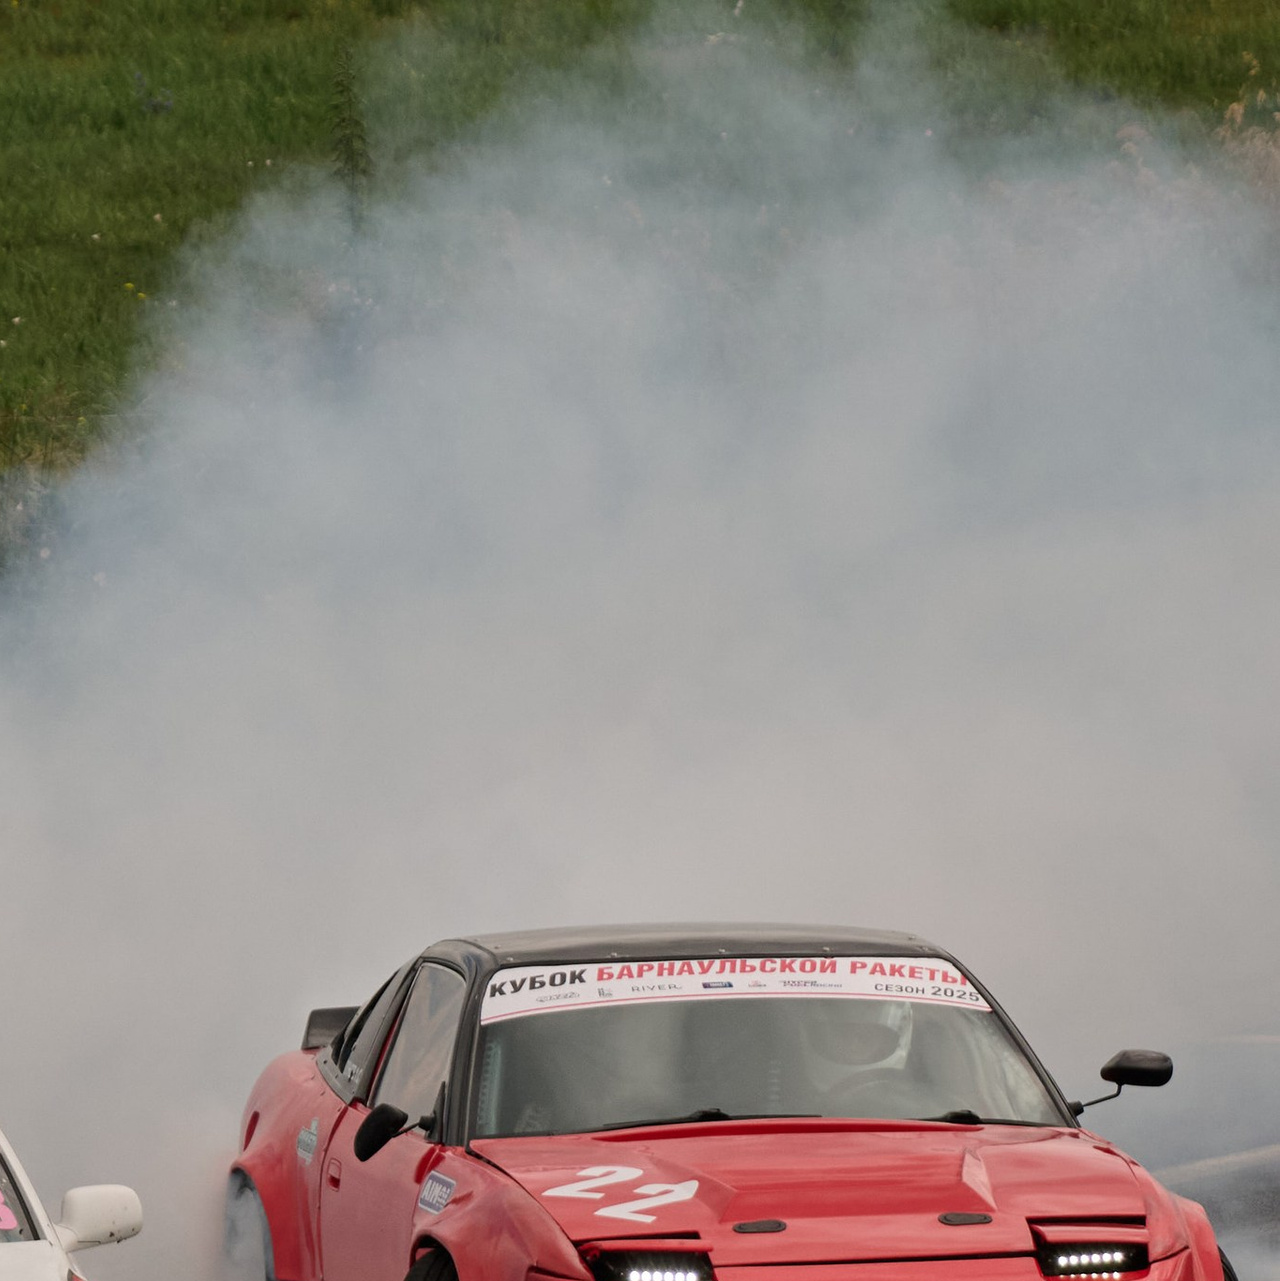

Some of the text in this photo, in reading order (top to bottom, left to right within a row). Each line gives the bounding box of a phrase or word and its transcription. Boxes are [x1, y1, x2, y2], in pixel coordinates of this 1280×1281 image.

[489, 969, 587, 998] КУБОК
[596, 957, 837, 982] БАРНАУЛЬСКОЙ
[850, 960, 969, 986] РАКЕТЫ
[874, 983, 980, 1002] СЕЗОН 2025
[541, 1166, 700, 1223] 22
